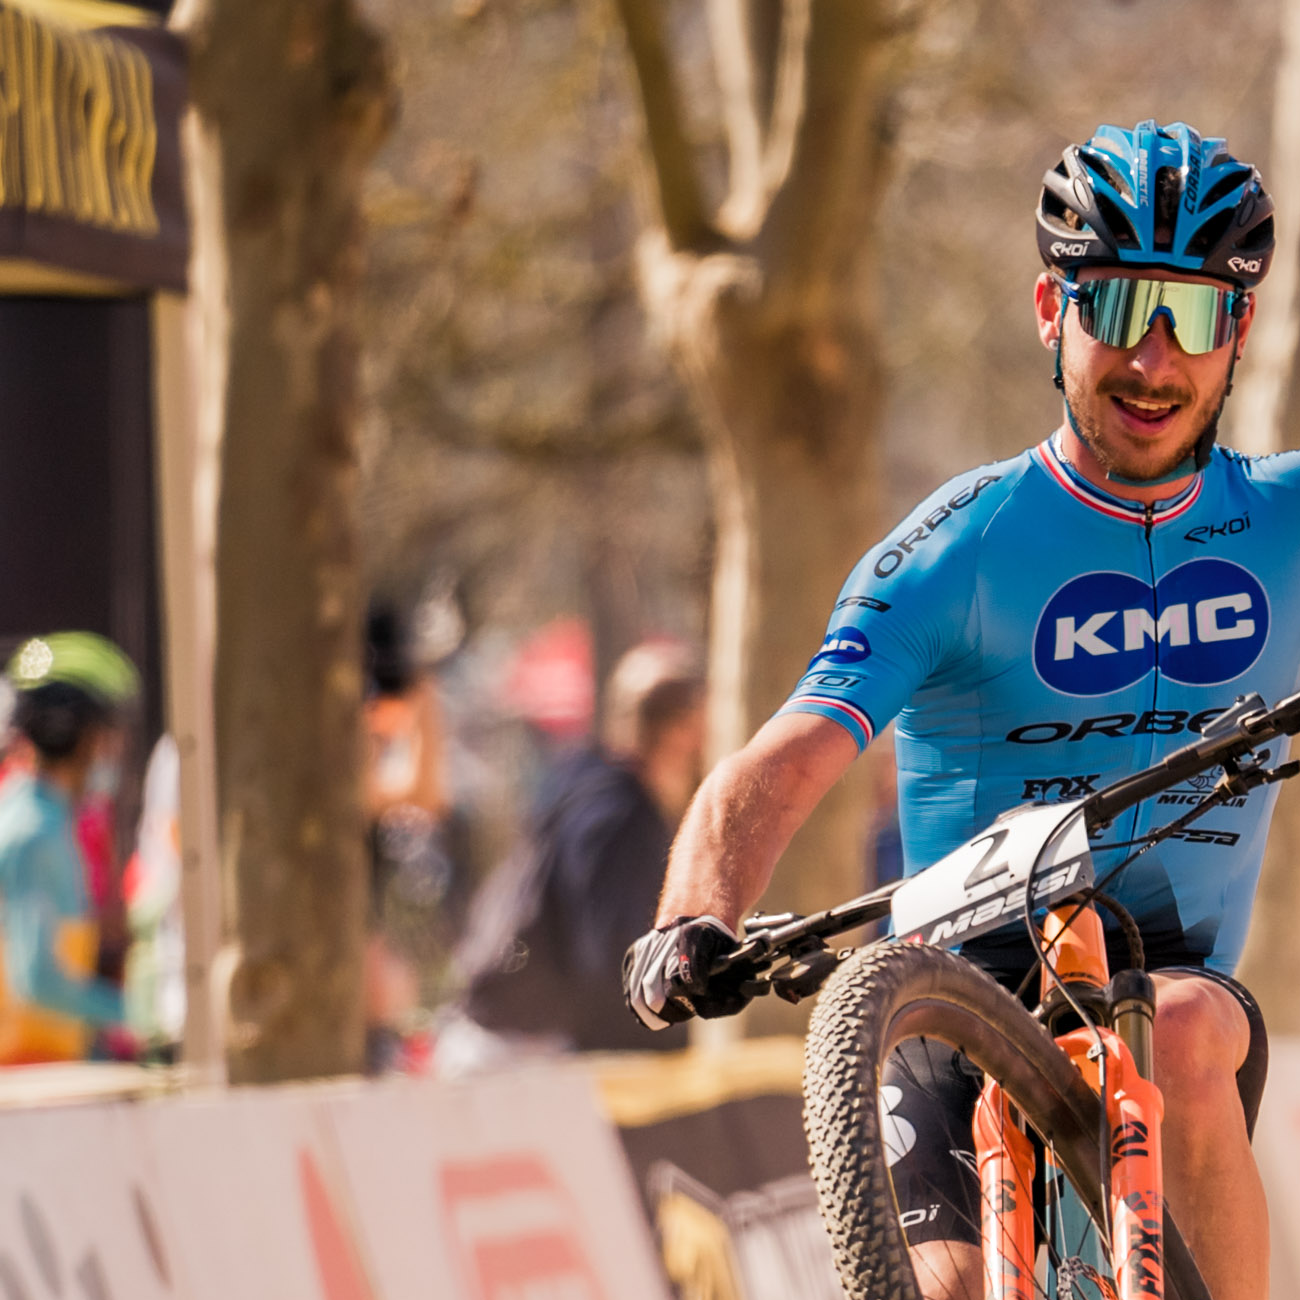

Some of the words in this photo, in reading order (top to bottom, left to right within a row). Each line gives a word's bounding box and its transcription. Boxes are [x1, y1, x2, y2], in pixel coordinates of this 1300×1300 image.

[873, 475, 1003, 579] ORBEA
[837, 596, 892, 613] SA
[1053, 591, 1256, 662] KMC
[1005, 708, 1229, 744] ORBE
[1021, 774, 1100, 801] FOX
[1157, 793, 1248, 808] MICLIN
[963, 828, 1010, 890] 2
